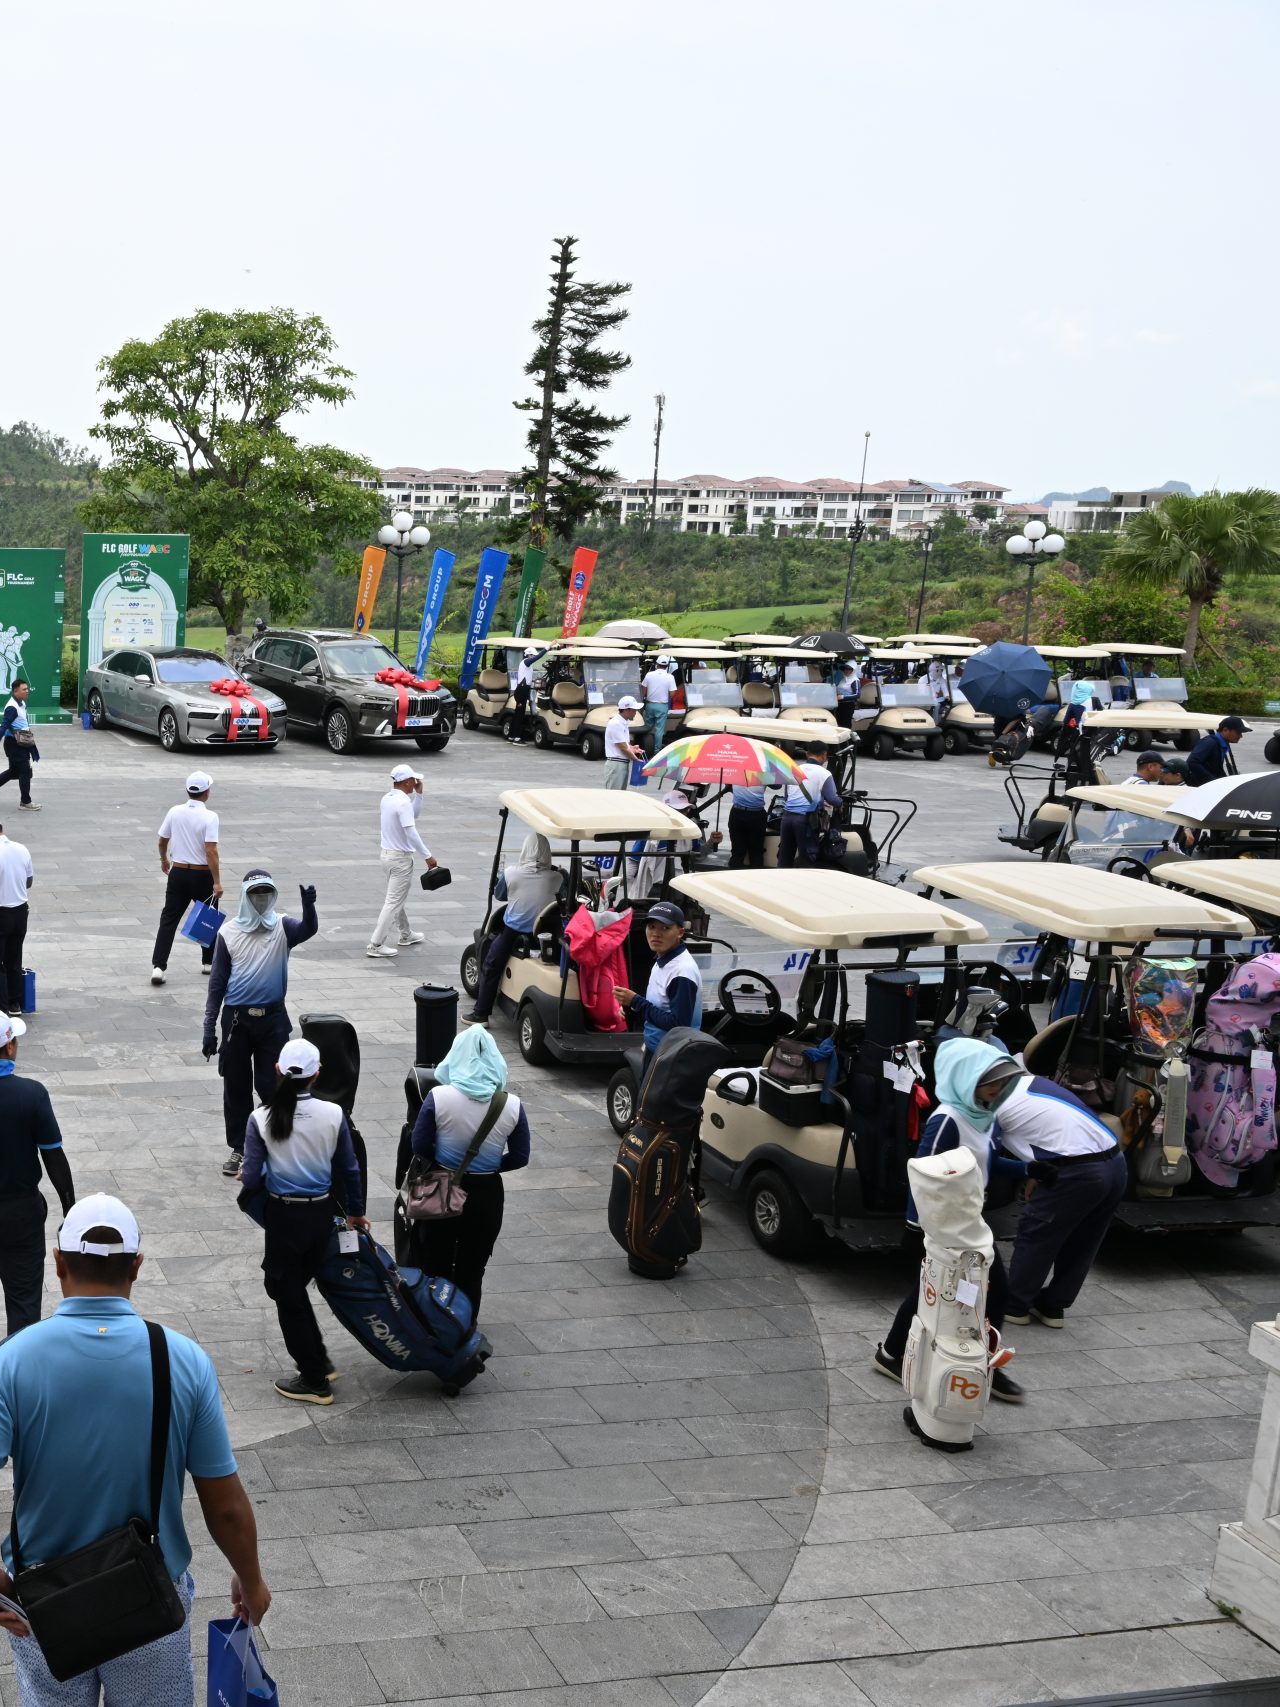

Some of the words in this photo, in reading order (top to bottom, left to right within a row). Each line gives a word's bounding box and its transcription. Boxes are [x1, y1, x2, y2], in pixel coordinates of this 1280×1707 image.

[102, 544, 116, 553] FLC
[118, 544, 138, 553] GOLF
[139, 544, 170, 554] WAGC
[430, 568, 443, 609] GROUP
[466, 635, 478, 664] FLC
[473, 574, 494, 635] BISCOM
[1226, 808, 1273, 821] PING
[384, 1280, 402, 1312] HONMA
[362, 1314, 412, 1361] HONMA
[950, 1375, 980, 1400] PG
